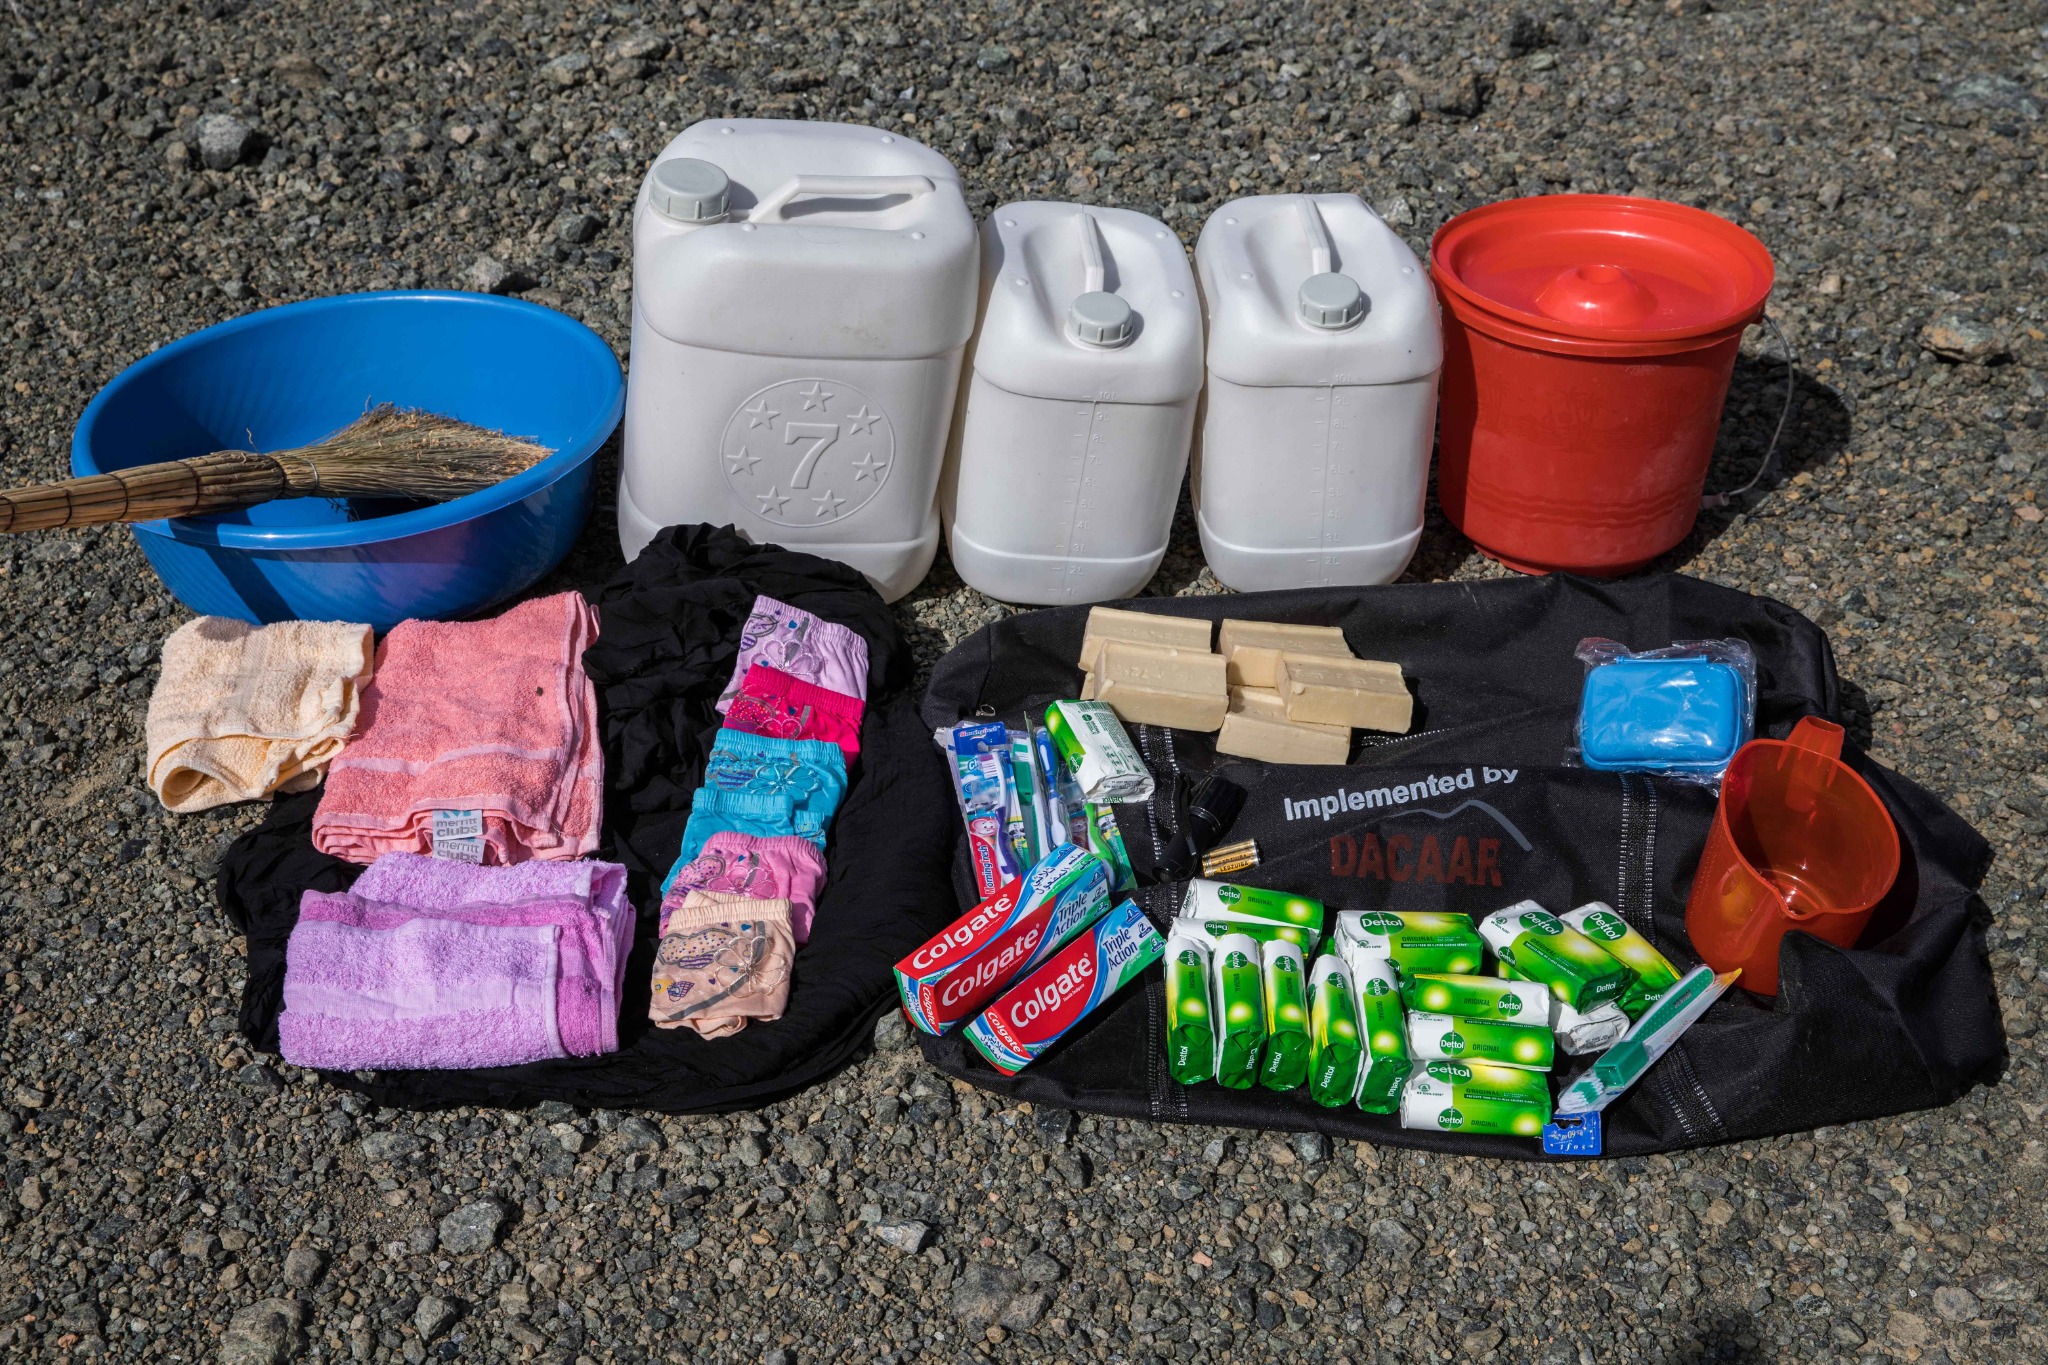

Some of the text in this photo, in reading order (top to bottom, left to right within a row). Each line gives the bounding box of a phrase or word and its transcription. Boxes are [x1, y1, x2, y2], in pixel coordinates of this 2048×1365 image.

[784, 422, 839, 490] 7
[1284, 766, 1519, 821] Implemented by
[436, 818, 478, 827] merritt
[436, 826, 478, 837] clubs
[436, 850, 478, 863] clubs
[438, 840, 480, 853] merritt
[984, 845, 995, 895] Morningfresh
[1330, 832, 1503, 887] DACAAR
[1218, 888, 1241, 900] Dettol
[1058, 892, 1088, 922] Triple
[1053, 906, 1087, 938] Action
[1205, 922, 1228, 932] Dettol
[1361, 917, 1403, 928] Dettol
[1523, 911, 1560, 935] Dettol
[1589, 912, 1621, 941] Dettol
[913, 897, 1012, 970] Colgate
[1102, 928, 1131, 954] Triple
[1109, 940, 1138, 969] Action
[1530, 937, 1556, 957] ORIGINAL
[942, 930, 1041, 1007] Colgate
[1187, 950, 1195, 966] Dettol
[1498, 950, 1516, 966] Dettol
[1011, 959, 1093, 1028] Colgate
[1373, 978, 1381, 996] Dettol
[1596, 981, 1617, 993] Dettol
[922, 986, 936, 1025] Colgate
[1464, 998, 1522, 1010] ORIGINAL Dettol
[988, 1012, 1022, 1053] Colgate
[1177, 1045, 1188, 1066] Dettol
[1440, 1040, 1500, 1053] Dettol ORIGINAL
[1246, 1048, 1257, 1070] Dettol
[1269, 1051, 1282, 1073] Dettol
[1321, 1065, 1335, 1088] Dettol
[1428, 1066, 1471, 1078] Dettol
[1387, 1077, 1402, 1097] Dettol
[1466, 1088, 1500, 1096] ORIGINAL
[1439, 1115, 1499, 1128] Dettol ORIGINAL
